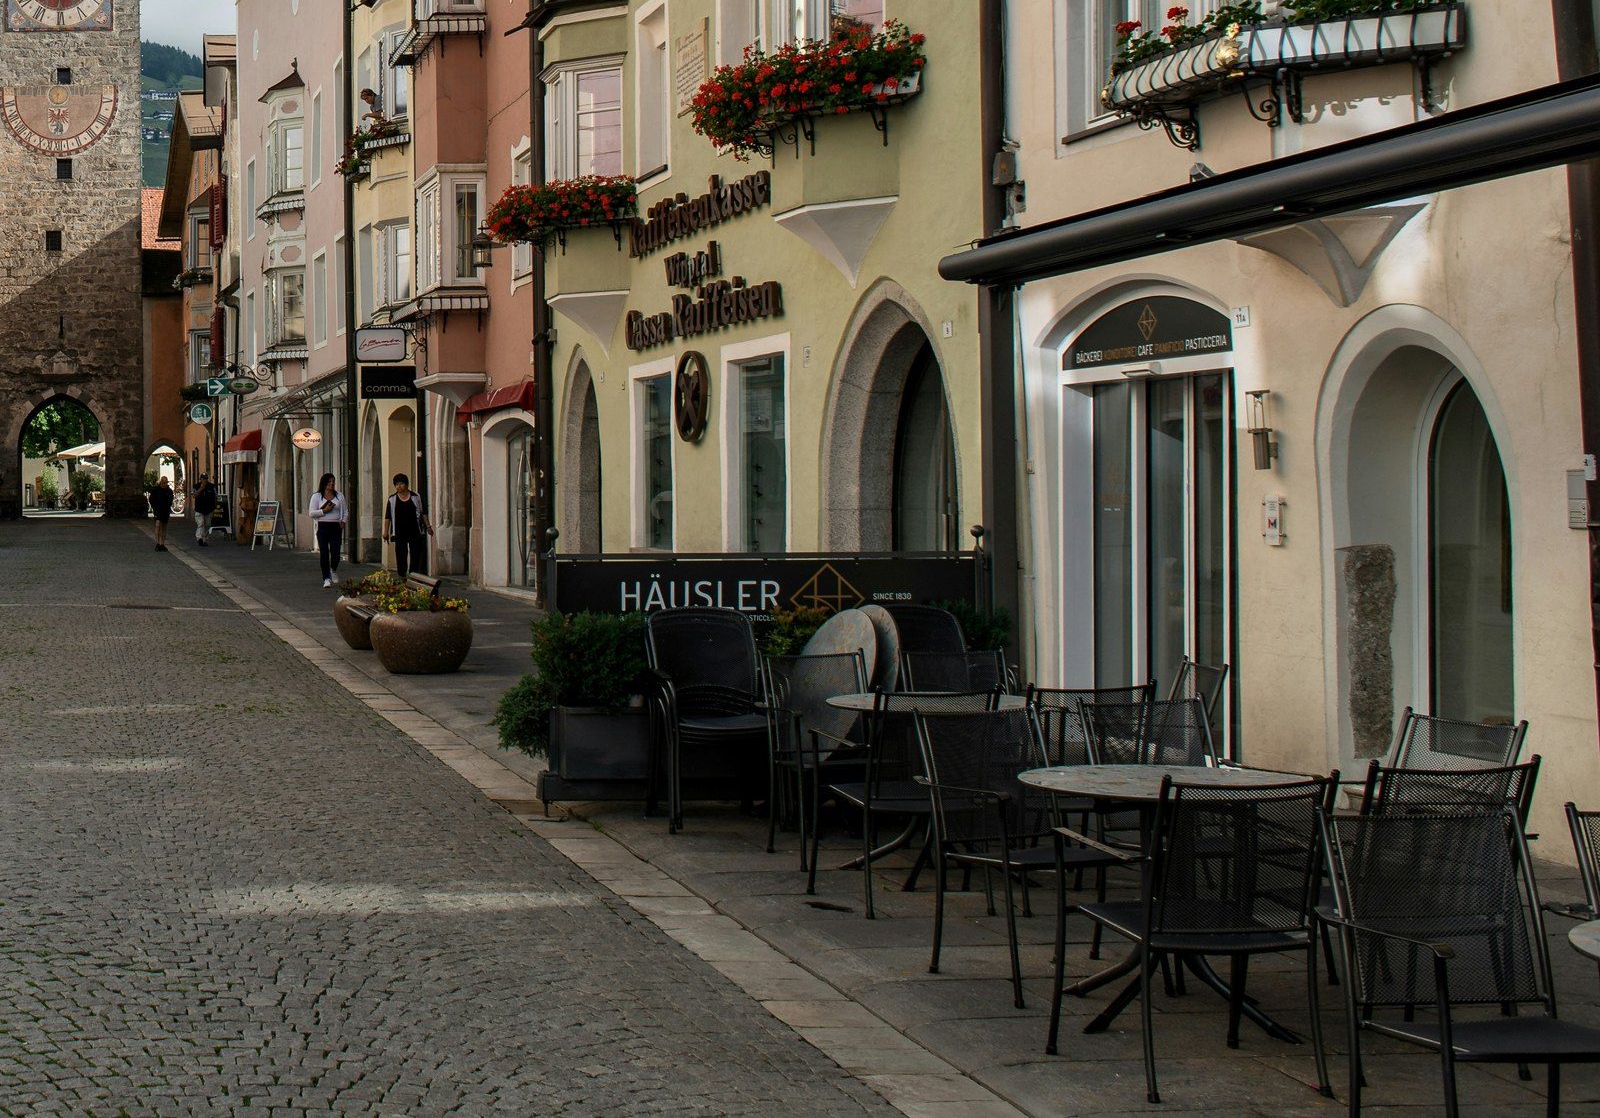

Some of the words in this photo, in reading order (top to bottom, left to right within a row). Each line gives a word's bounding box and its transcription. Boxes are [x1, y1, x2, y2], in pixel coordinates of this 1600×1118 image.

[629, 170, 771, 258] Raiffeisenkasse
[664, 240, 720, 288] Wipptal
[625, 309, 674, 351] Cassa
[671, 275, 783, 337] Raiffeisen
[1076, 350, 1103, 364] BÄCKEREI
[1185, 334, 1228, 351] PASTICCERIA
[621, 573, 781, 611] HÄUSLER
[872, 592, 894, 601] SINCE
[895, 592, 912, 601] 1830
